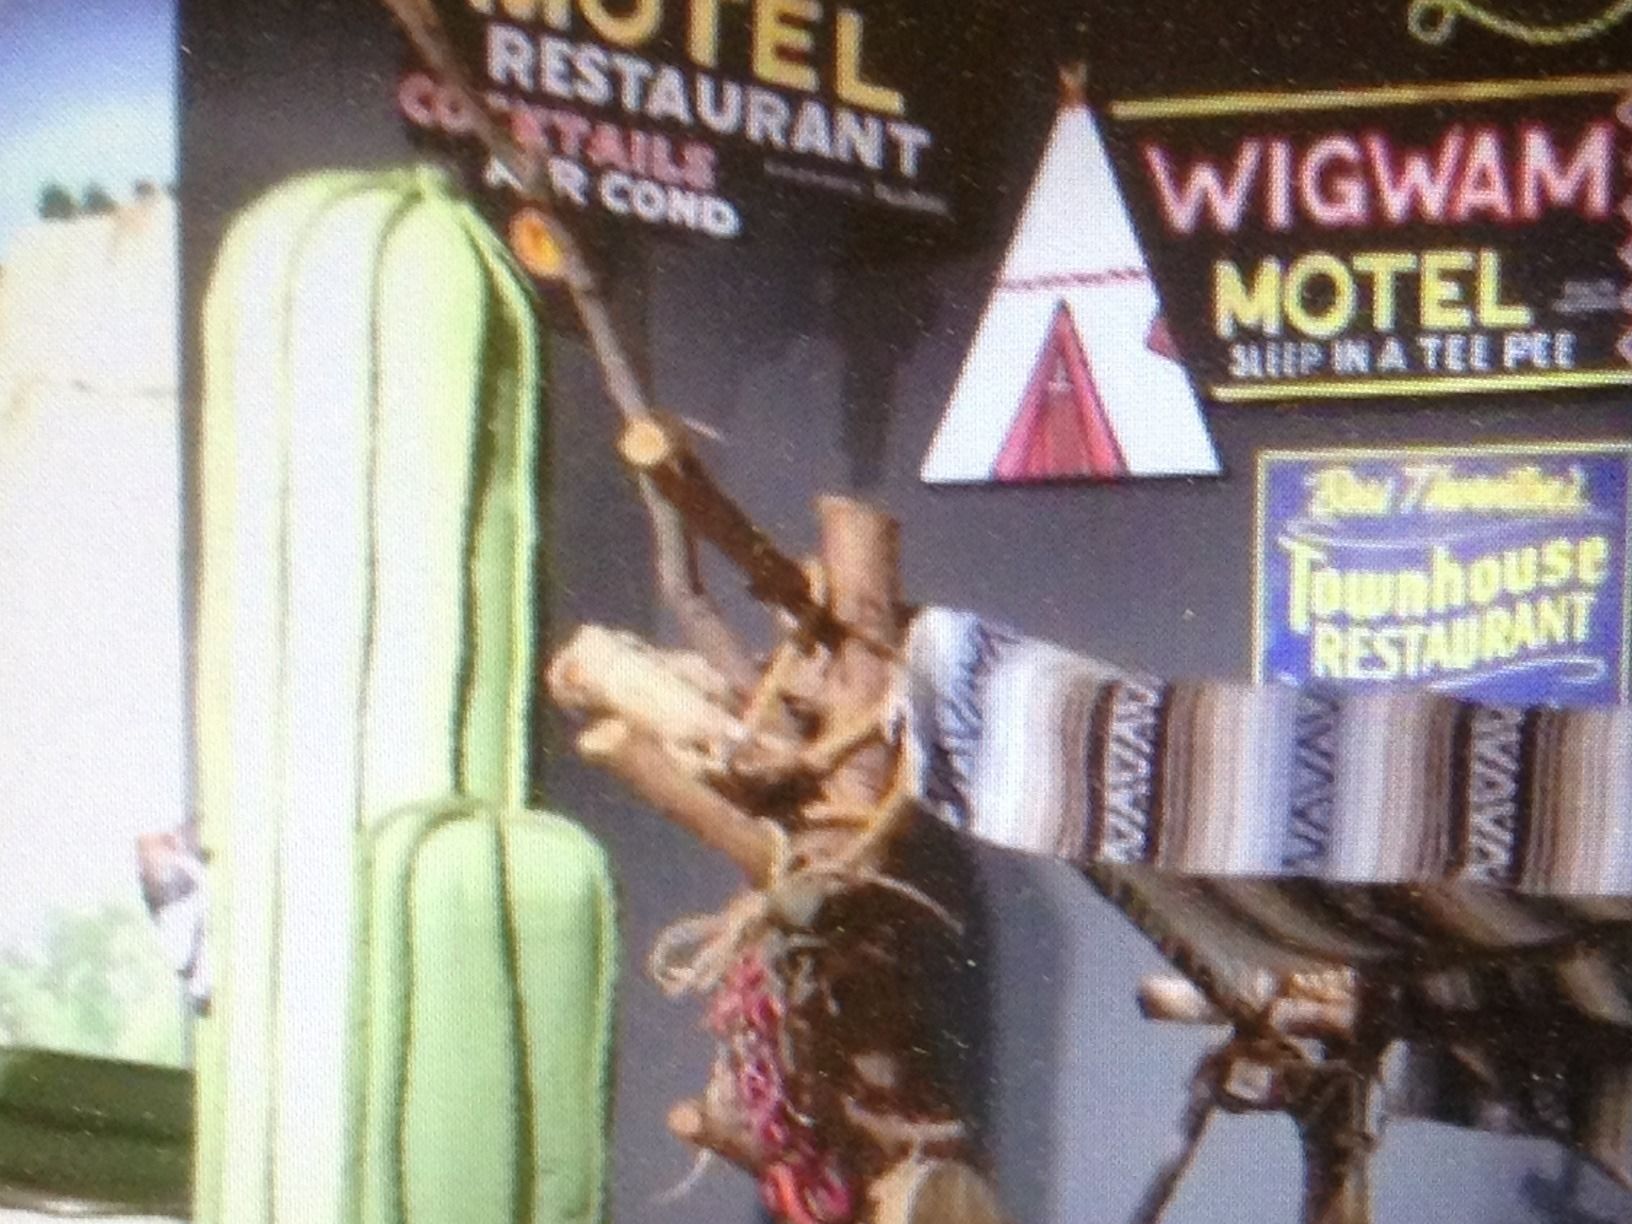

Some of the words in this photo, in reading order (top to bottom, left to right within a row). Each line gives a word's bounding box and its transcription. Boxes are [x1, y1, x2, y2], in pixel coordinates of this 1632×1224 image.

[486, 22, 932, 178] RESTAURANT
[481, 152, 590, 208] AR
[599, 168, 742, 239] COND
[1140, 118, 1616, 236] WIGWAM
[1212, 247, 1534, 341] MOTEL
[1228, 340, 1326, 378] SLEEP
[1330, 337, 1371, 373] IN
[1375, 335, 1409, 372] A
[1418, 331, 1493, 373] TEE
[1502, 329, 1578, 370] PEE
[1278, 535, 1611, 635] Townhouse
[1312, 590, 1597, 681] RESTAURANT
